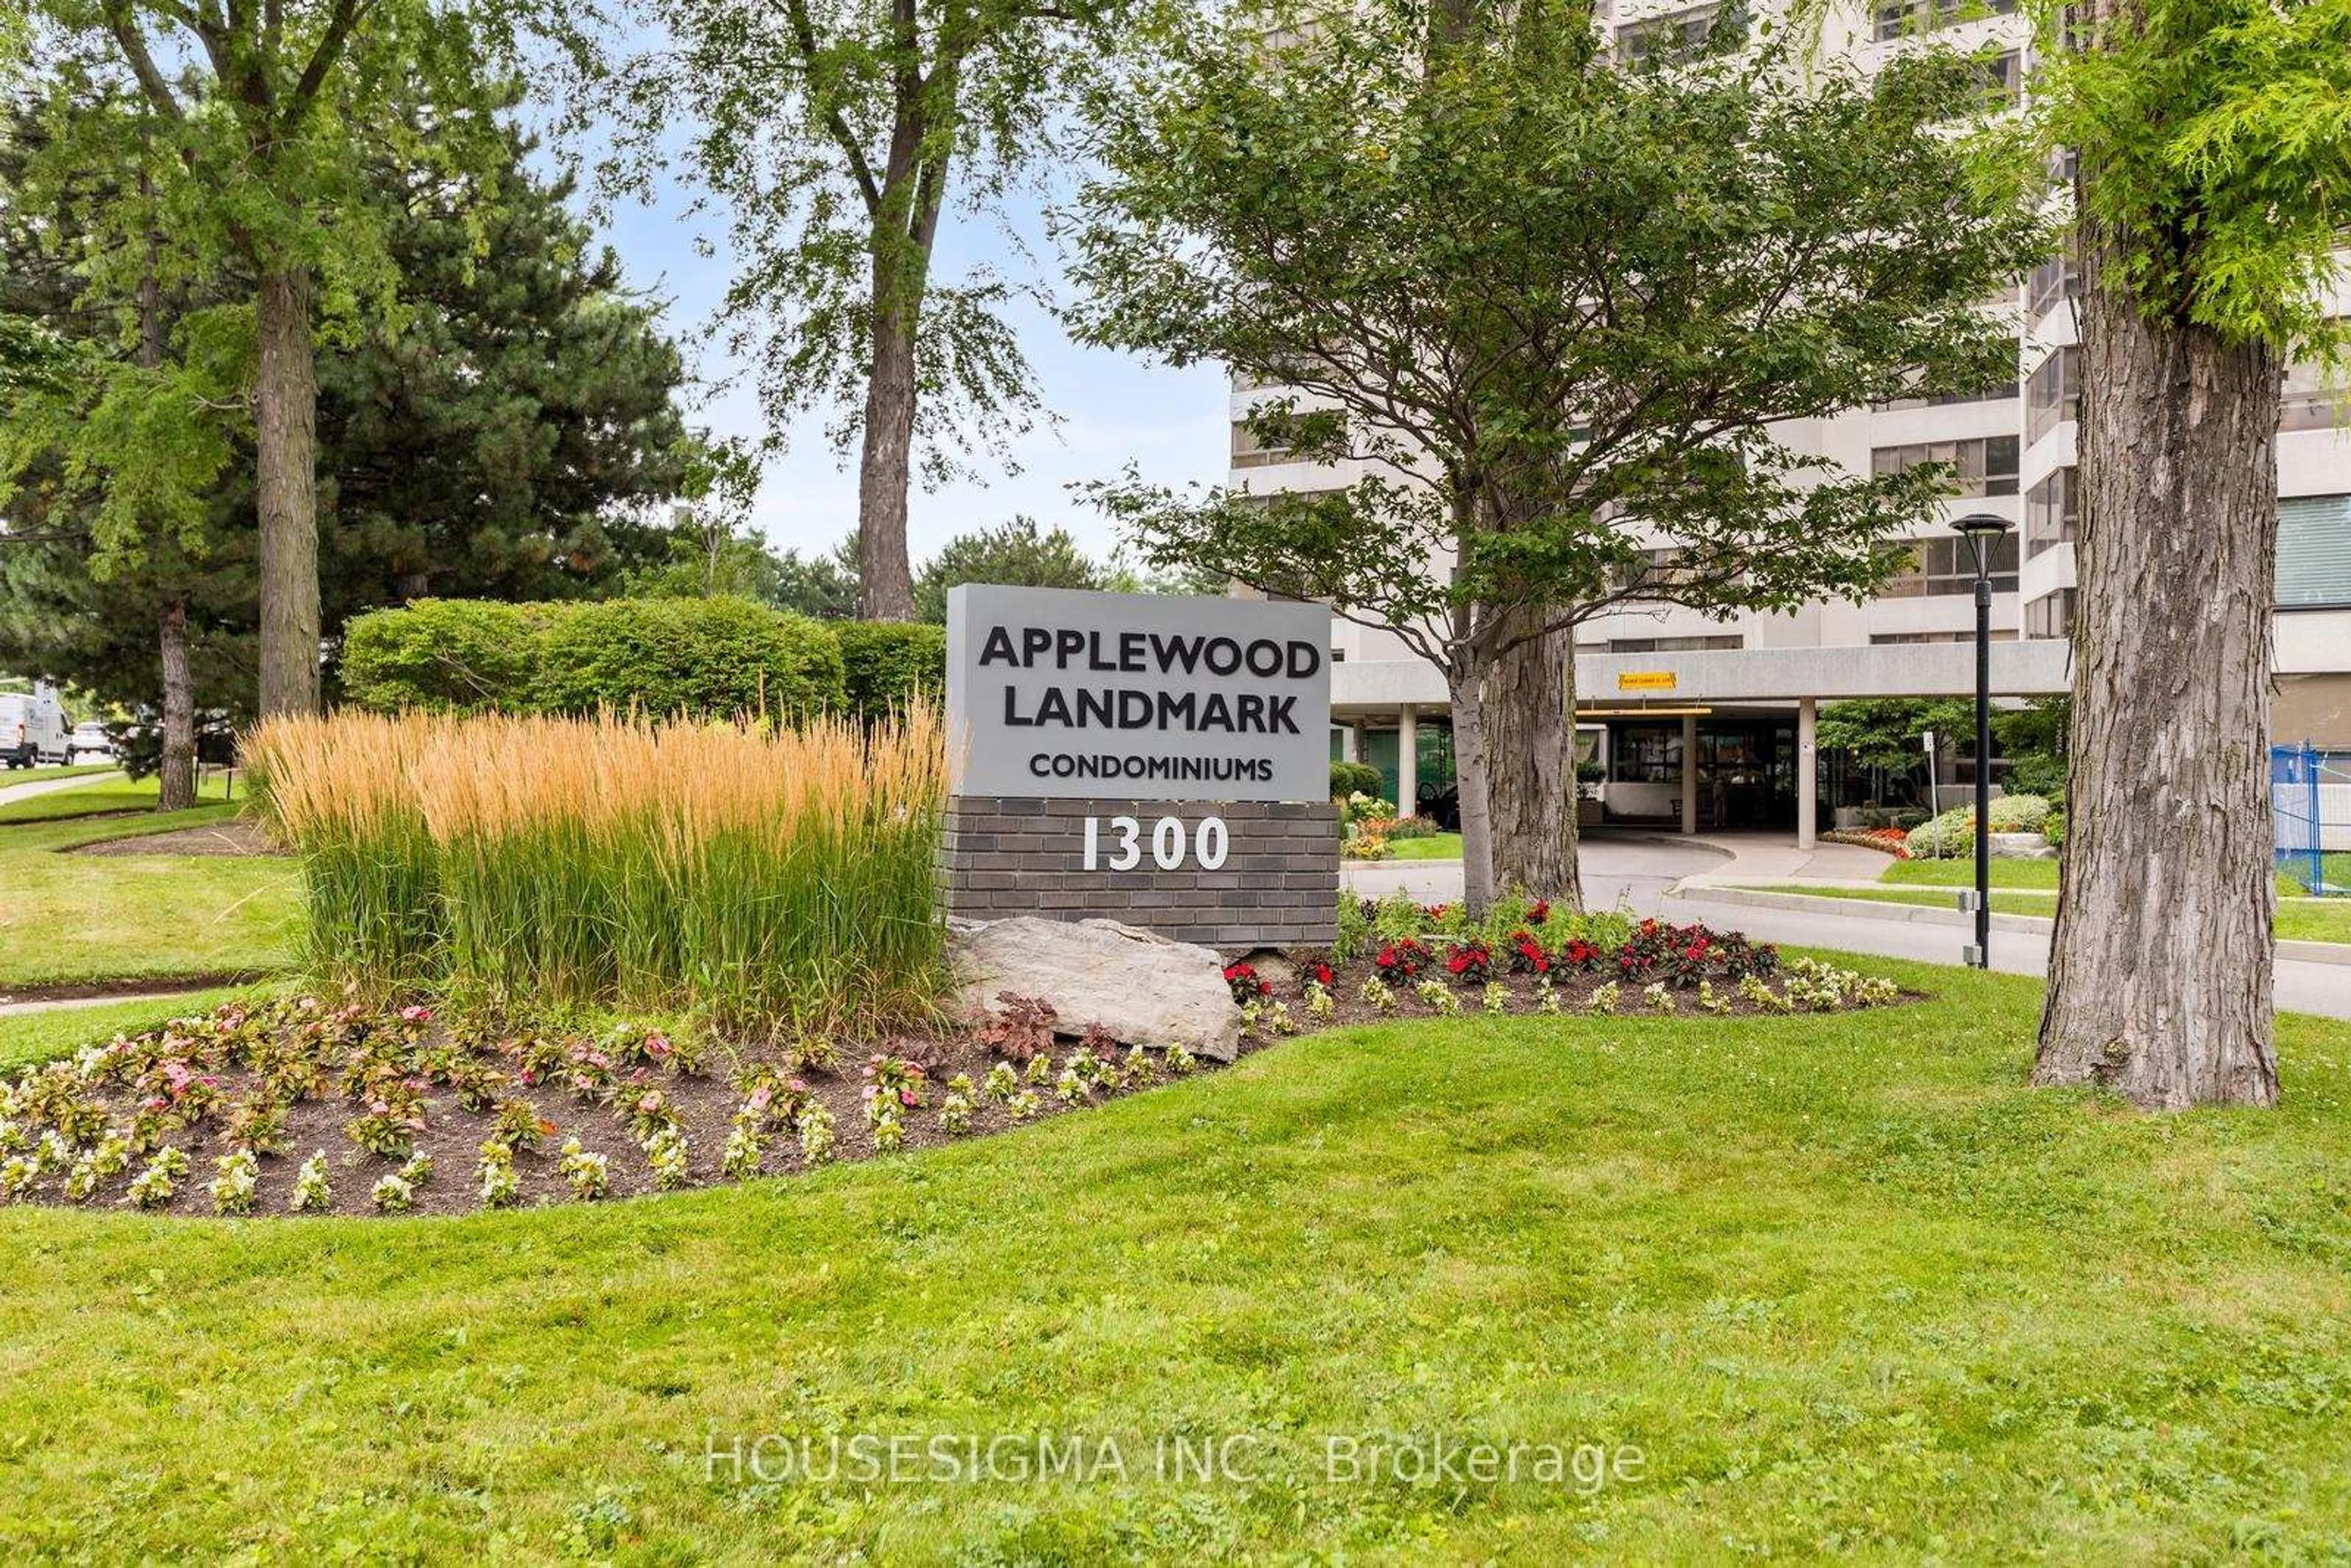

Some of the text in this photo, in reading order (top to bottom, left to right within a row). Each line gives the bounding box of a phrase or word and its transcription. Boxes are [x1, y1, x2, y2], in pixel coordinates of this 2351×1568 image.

[978, 625, 1321, 678] APPLEWOOD
[1004, 685, 1301, 735] LANDMARK
[1029, 754, 1273, 781] CONDOMINIUMS
[1083, 816, 1229, 871] 1300
